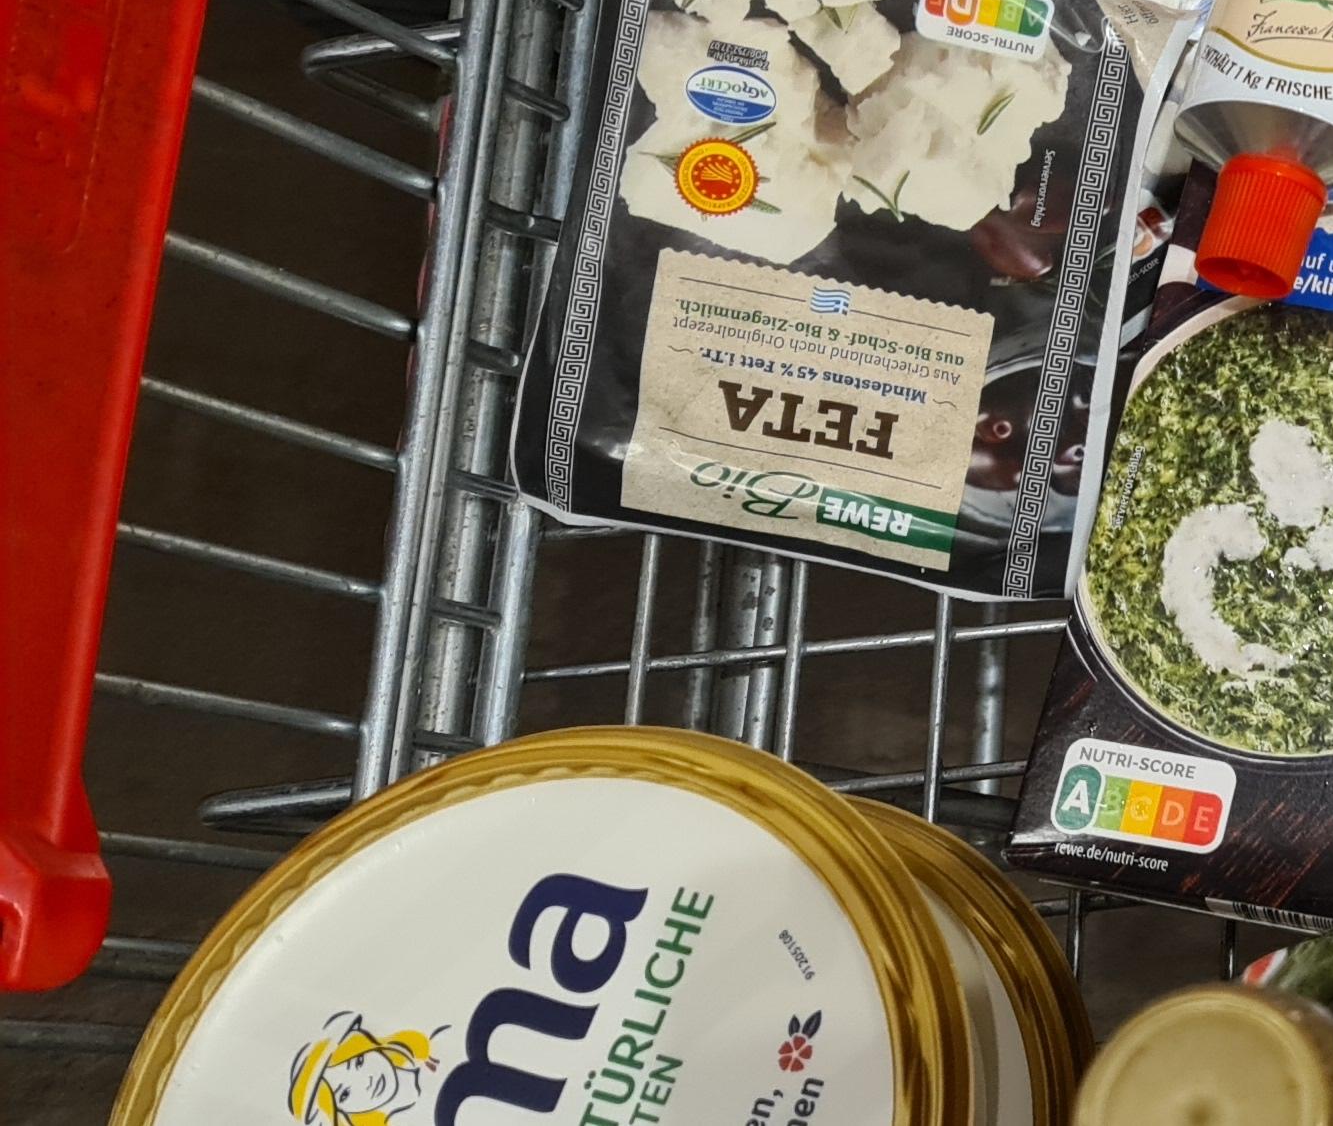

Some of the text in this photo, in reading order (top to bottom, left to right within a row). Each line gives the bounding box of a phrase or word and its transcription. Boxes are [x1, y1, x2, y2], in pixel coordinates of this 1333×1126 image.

[946, 24, 1035, 56] NUTRI-SCORE
[1265, 76, 1333, 100] FRISCHE
[1030, 148, 1056, 229] Serviervorschlag
[675, 299, 824, 344] Bio-Ziegenmilch.
[672, 316, 961, 385] Aus Griechenland nach Originalrezept
[844, 331, 929, 363] Bio-Schaf-
[933, 348, 966, 367] aus
[699, 346, 928, 405] Mindestens Fett i.Tr.
[718, 379, 900, 460] FETA
[689, 460, 913, 538] REWE Bio
[1079, 746, 1197, 782] NUTRI-SCORE
[1054, 840, 1170, 873] rewe.de/nutri-score
[777, 929, 817, 982] 91205108
